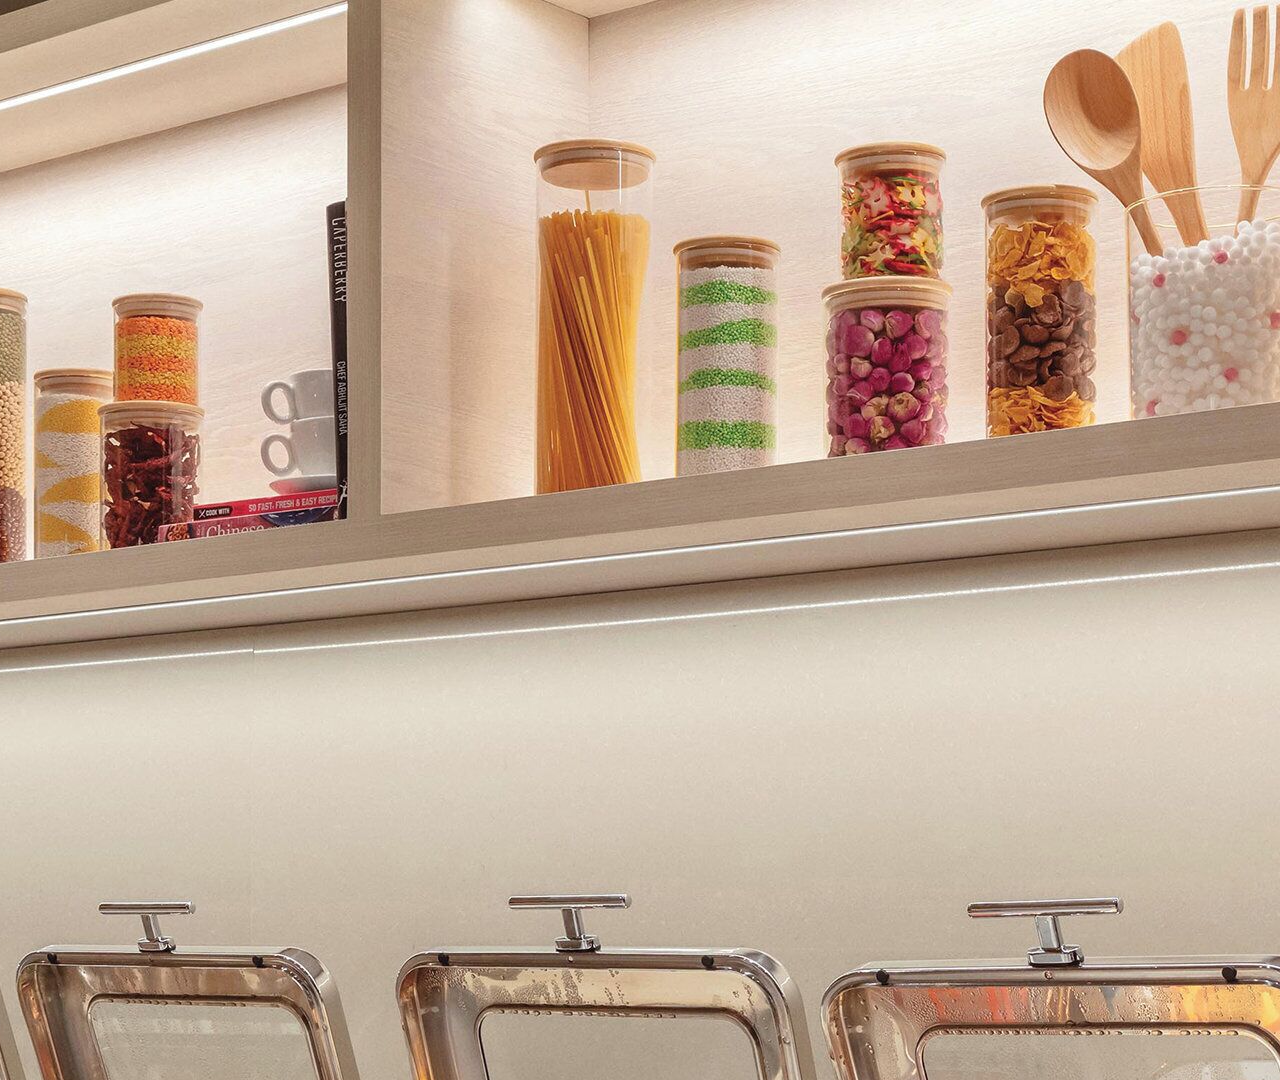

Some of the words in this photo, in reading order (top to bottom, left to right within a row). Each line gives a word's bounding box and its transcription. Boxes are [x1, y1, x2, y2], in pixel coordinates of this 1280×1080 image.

[332, 217, 347, 302] CAPERBERRY
[337, 361, 346, 381] CHEF
[339, 413, 347, 435] SAHA
[275, 499, 294, 509] FRESH
[301, 497, 317, 506] EASY
[318, 494, 338, 504] RECIP
[205, 509, 218, 517] COOK
